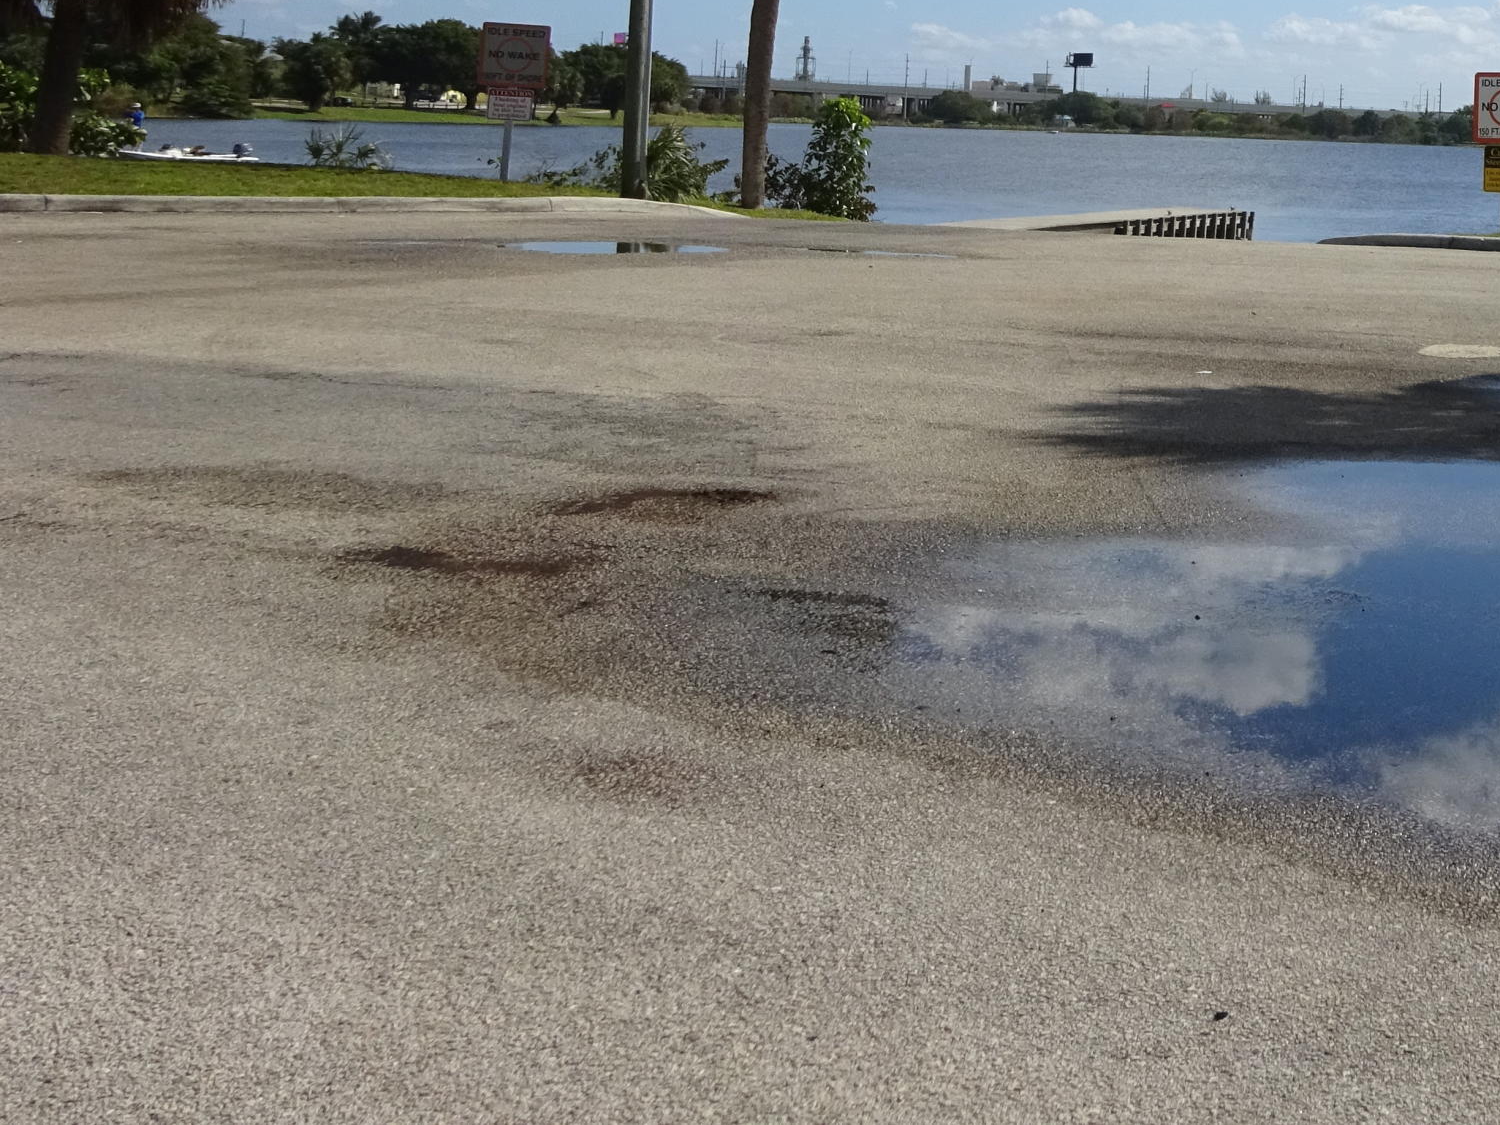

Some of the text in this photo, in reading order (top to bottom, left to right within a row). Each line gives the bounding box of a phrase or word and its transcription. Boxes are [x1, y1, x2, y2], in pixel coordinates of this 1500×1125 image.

[488, 50, 541, 60] NO WAKE
[1481, 102, 1499, 112] NO
[1479, 127, 1490, 136] 150
